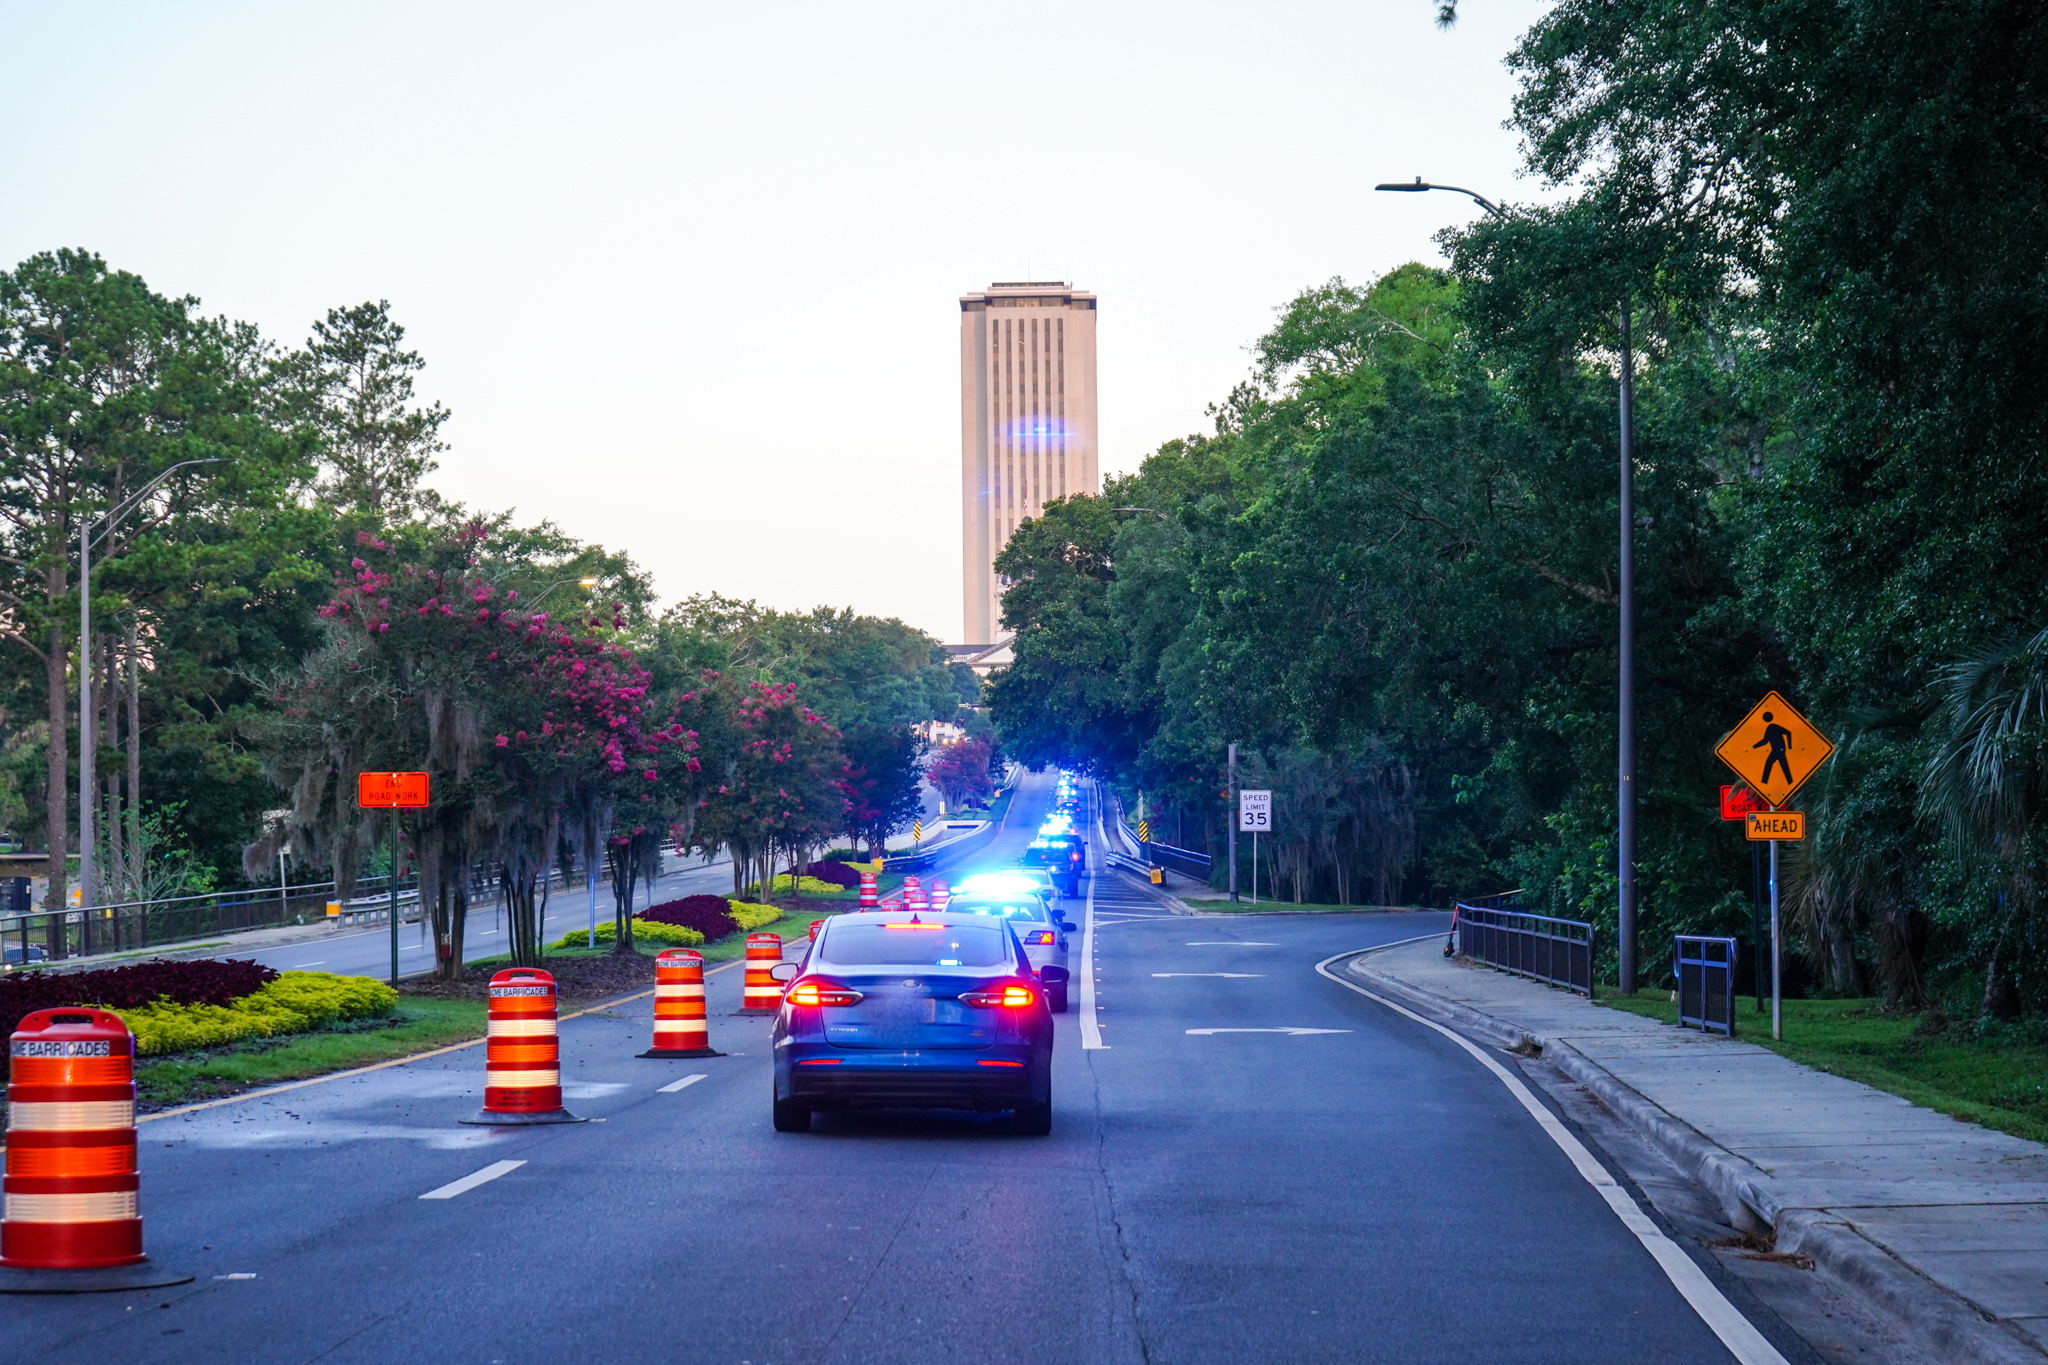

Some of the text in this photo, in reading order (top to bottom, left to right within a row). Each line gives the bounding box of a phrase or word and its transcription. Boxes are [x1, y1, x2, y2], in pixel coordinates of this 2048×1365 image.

[385, 780, 402, 788] END
[369, 791, 419, 800] ROAD WORK
[1730, 804, 1753, 813] ROAD
[1244, 812, 1267, 825] 35
[1754, 819, 1798, 833] AHEAD
[503, 987, 548, 996] BARRICADES
[29, 1041, 110, 1056] BARRICADES
